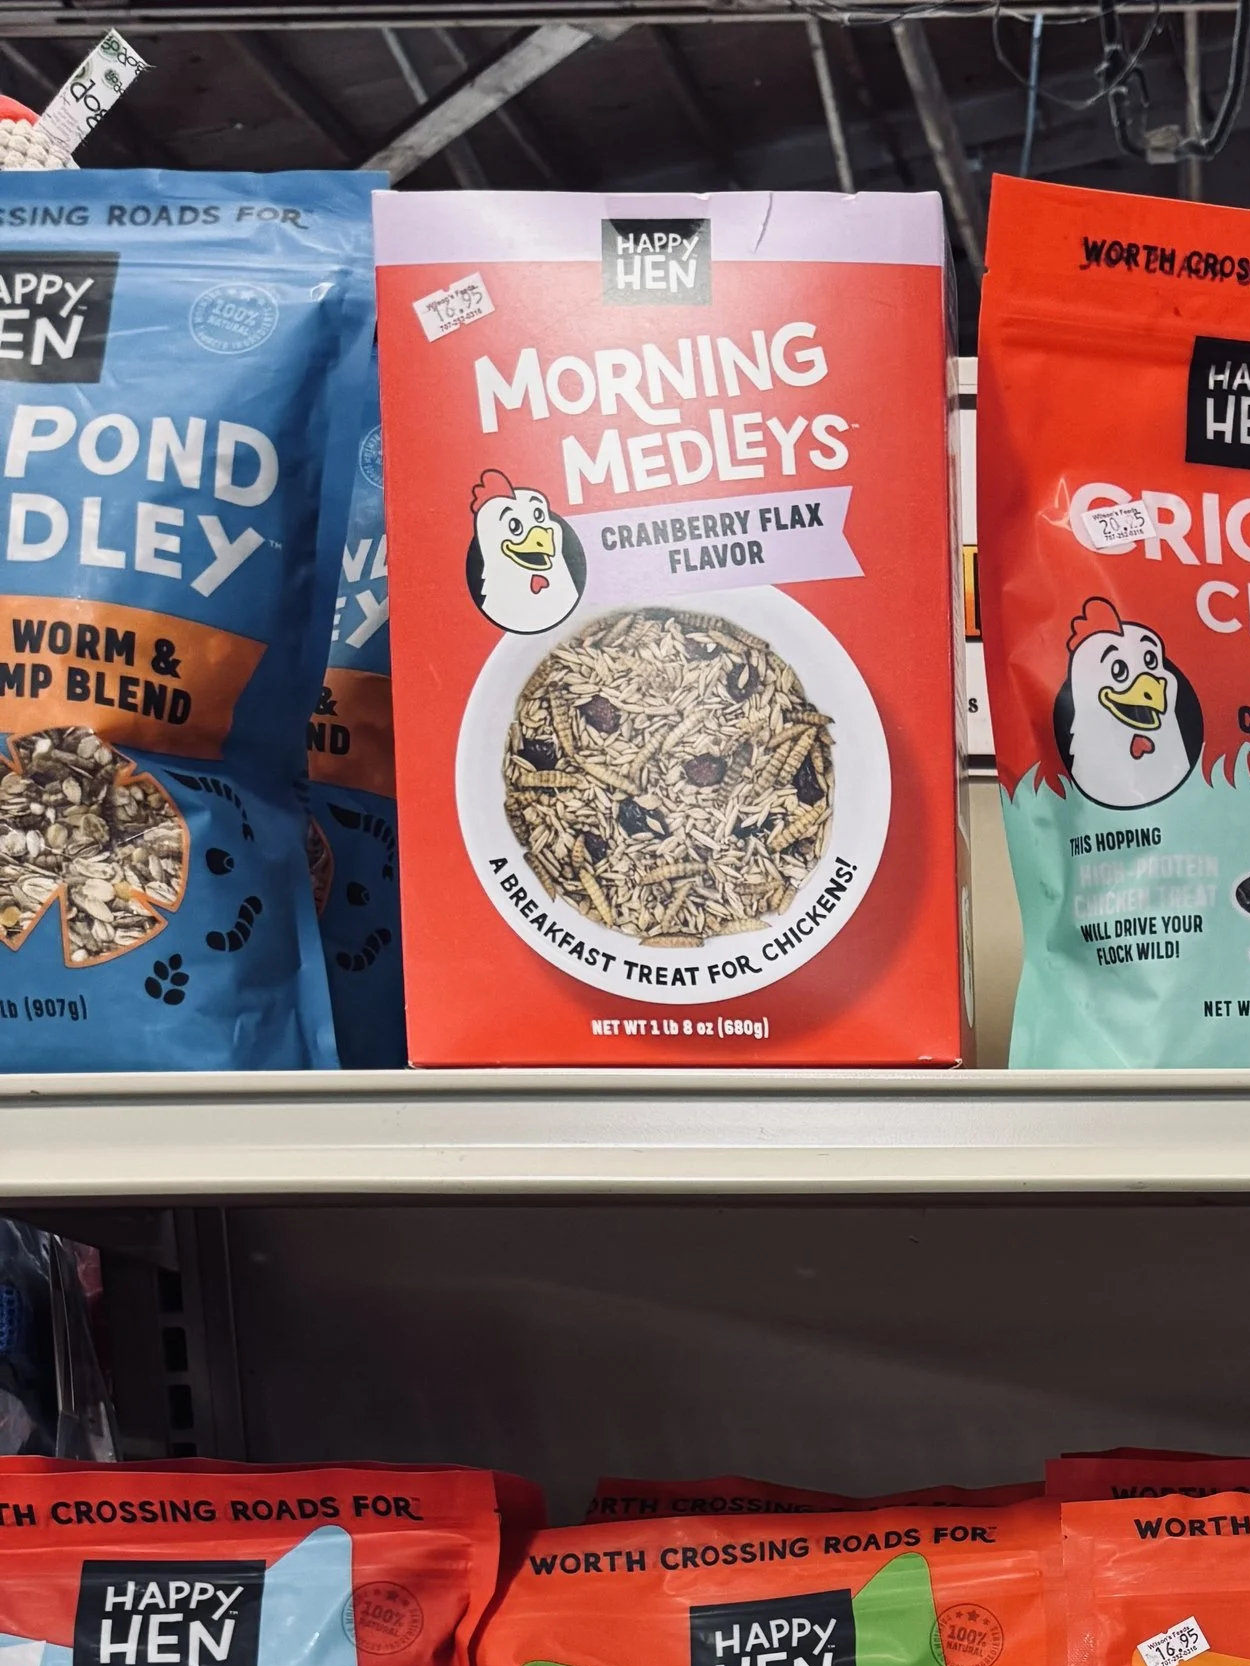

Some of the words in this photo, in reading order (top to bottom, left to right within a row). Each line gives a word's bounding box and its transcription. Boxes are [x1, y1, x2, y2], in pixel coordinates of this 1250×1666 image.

[617, 233, 698, 262] HAPPY
[617, 255, 696, 292] HEN
[475, 322, 827, 433] MORNING
[5, 404, 279, 508] POND
[563, 409, 851, 505] MEDLEYS
[602, 510, 749, 551] CRANBERRY
[760, 503, 823, 531] FLAX
[669, 540, 764, 573] FLAVOR
[13, 619, 136, 667] WORM
[152, 639, 181, 679] &
[67, 668, 192, 725] BLEND
[1070, 835, 1094, 856] THIS
[1096, 827, 1161, 852] HOPPING
[489, 856, 508, 875] A
[500, 875, 617, 973] BREAKFAST
[624, 960, 700, 987] TREAT
[708, 956, 762, 983] FOR
[762, 855, 858, 962] CHICKENS!
[26, 995, 87, 1021] (907g)
[592, 1018, 620, 1036] NET
[623, 1018, 648, 1036] WT
[650, 1018, 660, 1036] 1
[663, 1018, 679, 1036] lb
[682, 1018, 694, 1036] 8
[697, 1021, 714, 1036] oz
[717, 1017, 769, 1039] (680g)
[105, 1581, 244, 1620] HAPPY
[715, 1618, 837, 1657] HAPPY
[1155, 1628, 1199, 1660] 16.95
